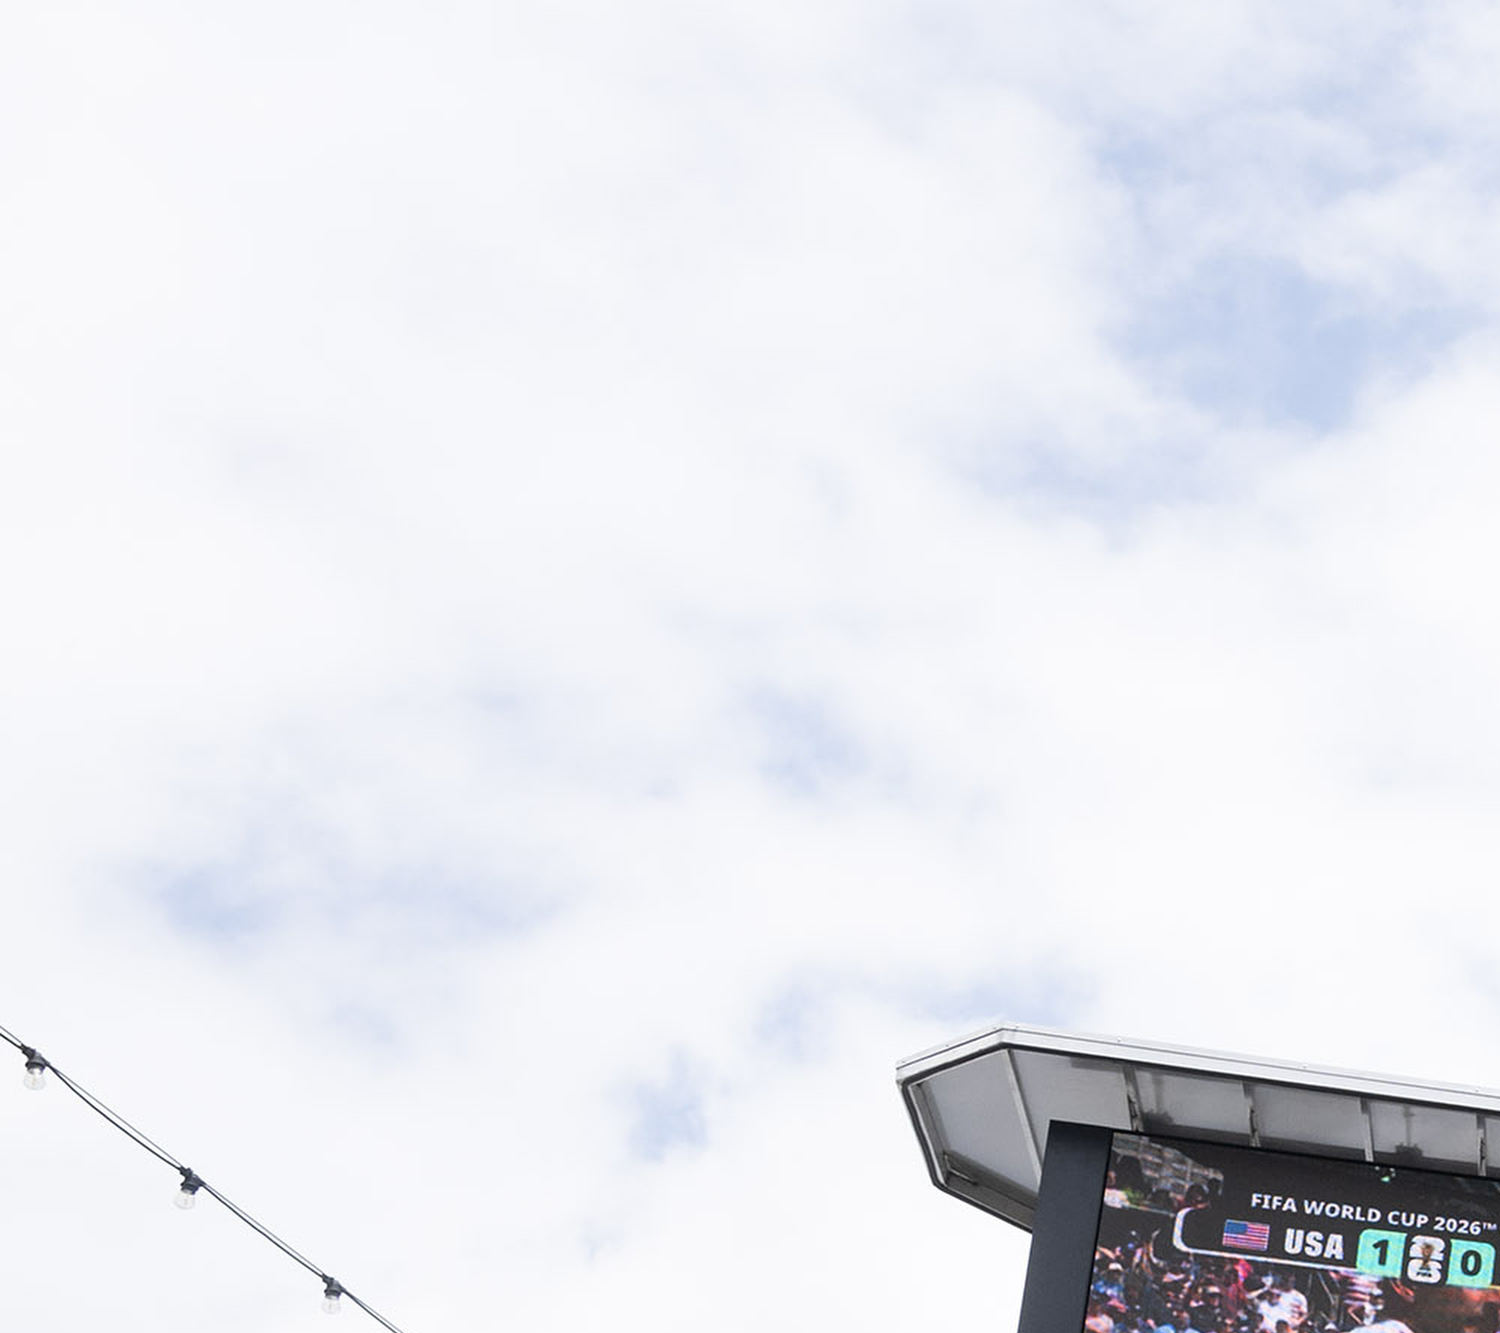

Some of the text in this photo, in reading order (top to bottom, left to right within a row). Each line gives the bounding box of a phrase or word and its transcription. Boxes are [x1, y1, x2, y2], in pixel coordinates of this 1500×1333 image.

[1251, 1193, 1298, 1214] FIFA
[1303, 1200, 1382, 1223] WORLD
[1387, 1210, 1430, 1228] CUP
[1284, 1227, 1345, 1261] USA
[1372, 1239, 1389, 1267] 1
[1460, 1249, 1483, 1277] 0
